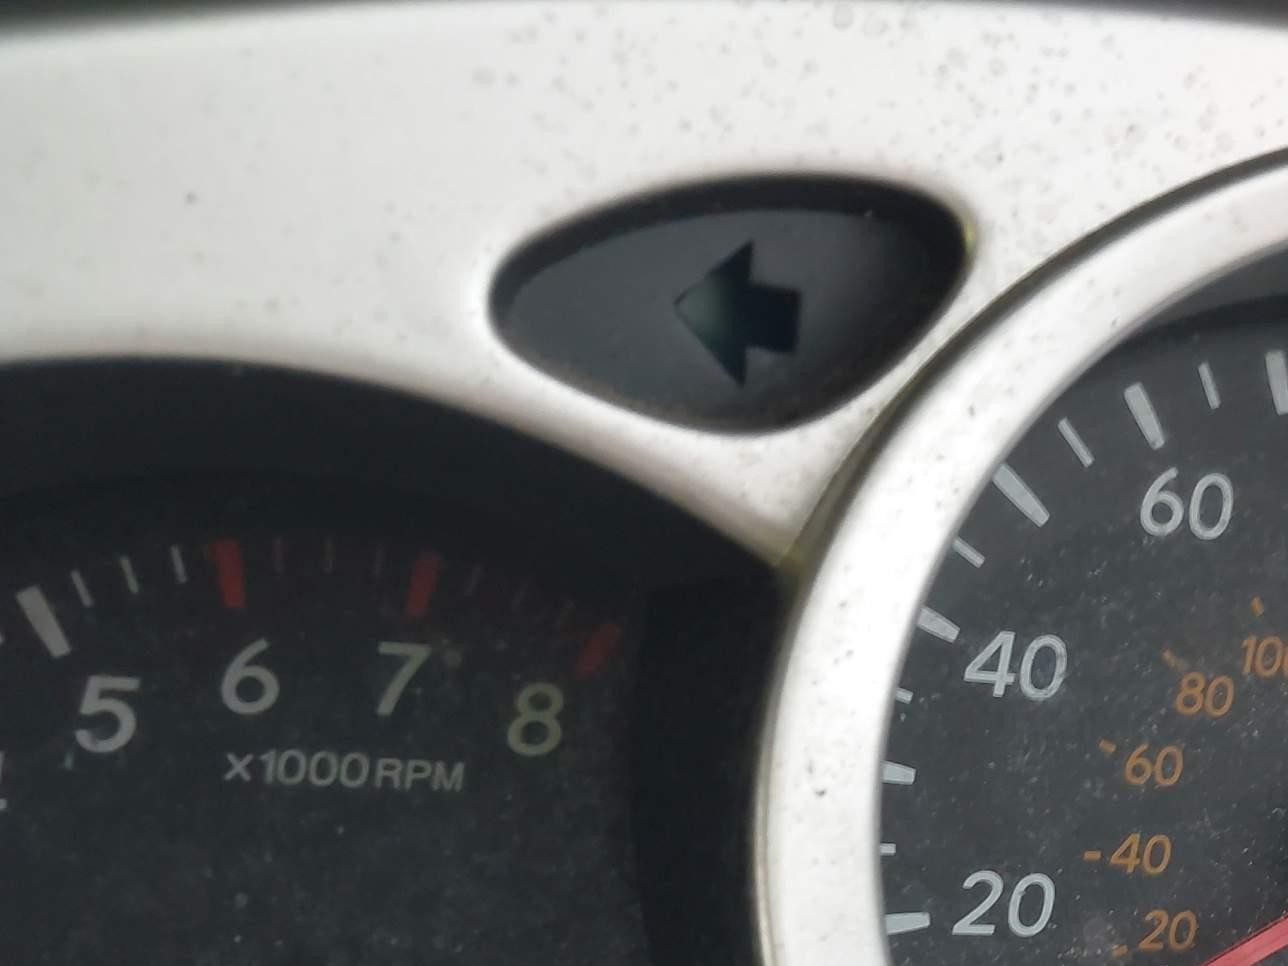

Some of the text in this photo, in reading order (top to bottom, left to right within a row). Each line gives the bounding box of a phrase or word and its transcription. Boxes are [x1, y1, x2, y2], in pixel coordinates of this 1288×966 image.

[1139, 466, 1235, 541] 60
[220, 639, 280, 715] 6
[376, 641, 432, 716] 7
[963, 630, 1068, 701] 40
[1175, 672, 1235, 718] 80
[75, 675, 141, 753] 5
[507, 683, 565, 757] 8
[1124, 744, 1185, 788] 60
[1108, 833, 1173, 876] 40
[952, 869, 1056, 938] 20
[1138, 909, 1199, 952] 20
